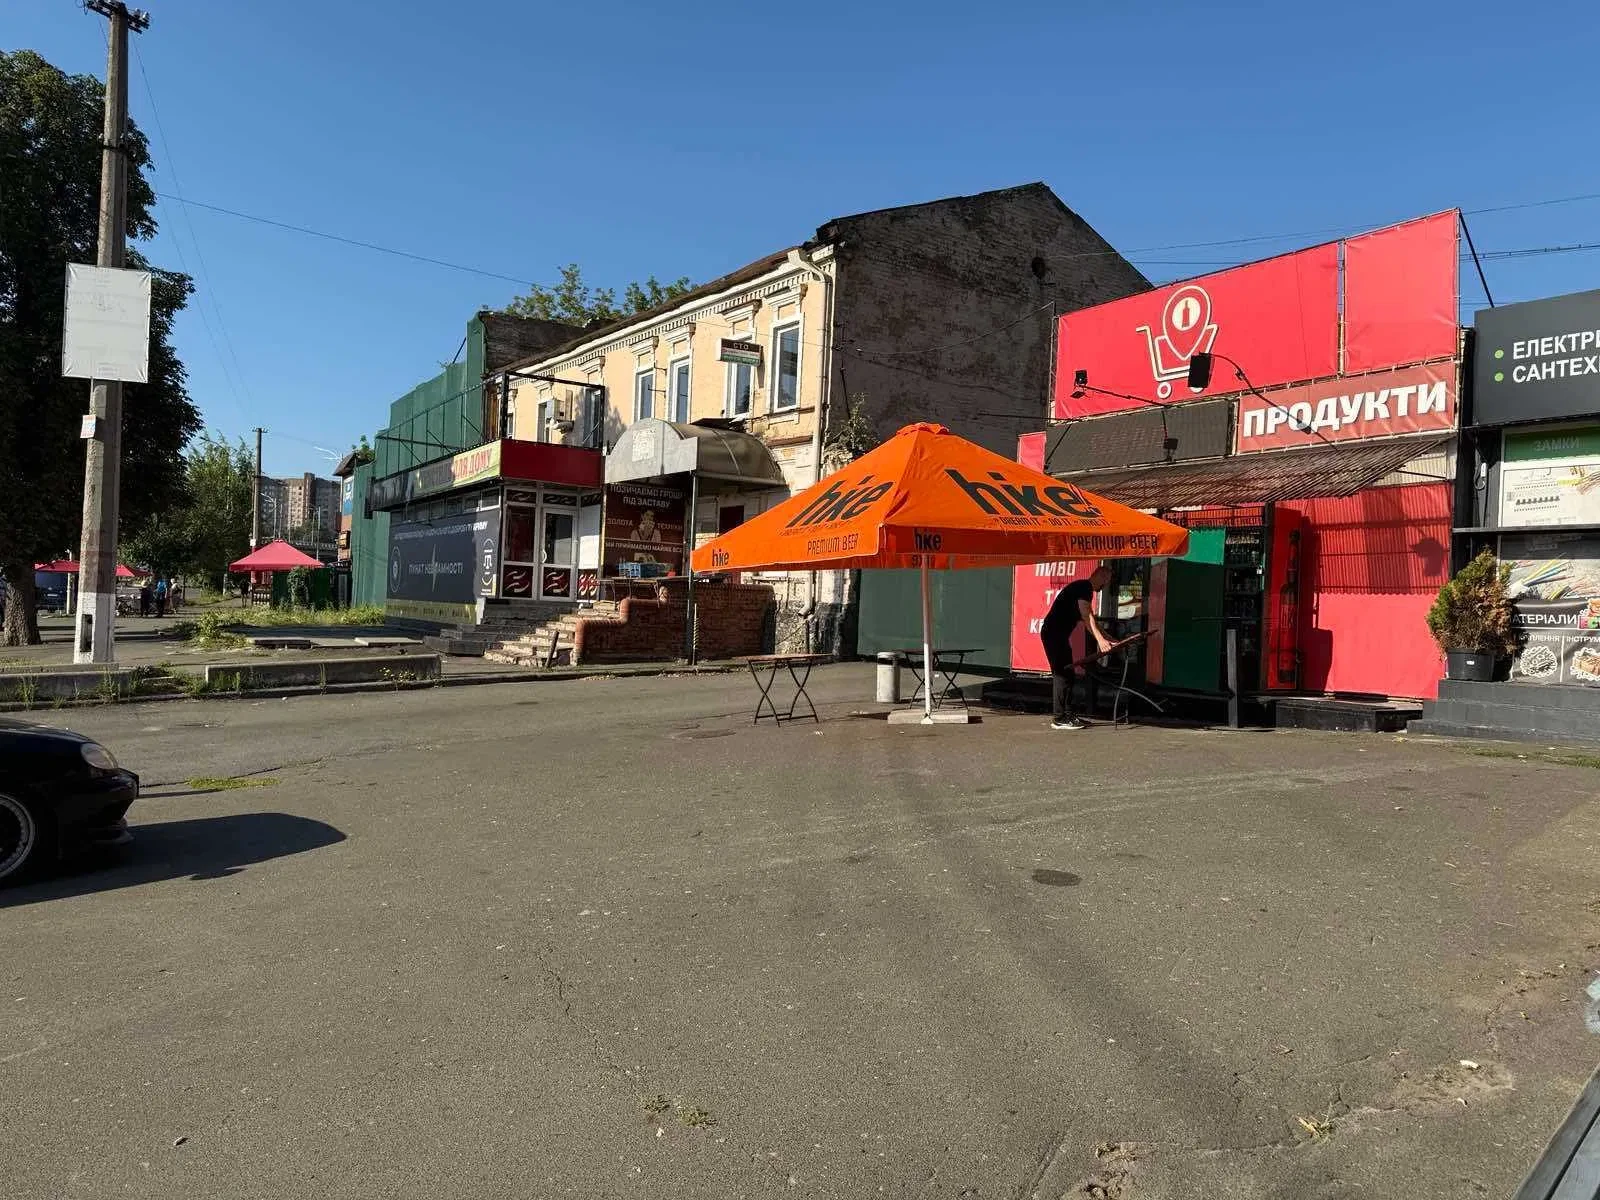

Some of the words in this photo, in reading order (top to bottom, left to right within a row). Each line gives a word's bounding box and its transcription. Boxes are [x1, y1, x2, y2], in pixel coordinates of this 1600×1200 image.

[1512, 356, 1600, 383] САНТЕХ
[1243, 382, 1447, 437] ПРОДУКТИ
[1534, 437, 1580, 451] ЗАМКИ
[807, 537, 840, 556] PREMIUM
[842, 533, 859, 550] BEER
[1070, 535, 1125, 550] PREMIUM
[1130, 534, 1158, 549] BEER
[712, 549, 729, 567] hike
[1035, 561, 1076, 576] ПИВО
[1508, 613, 1577, 625] АТЕРІАЛИ
